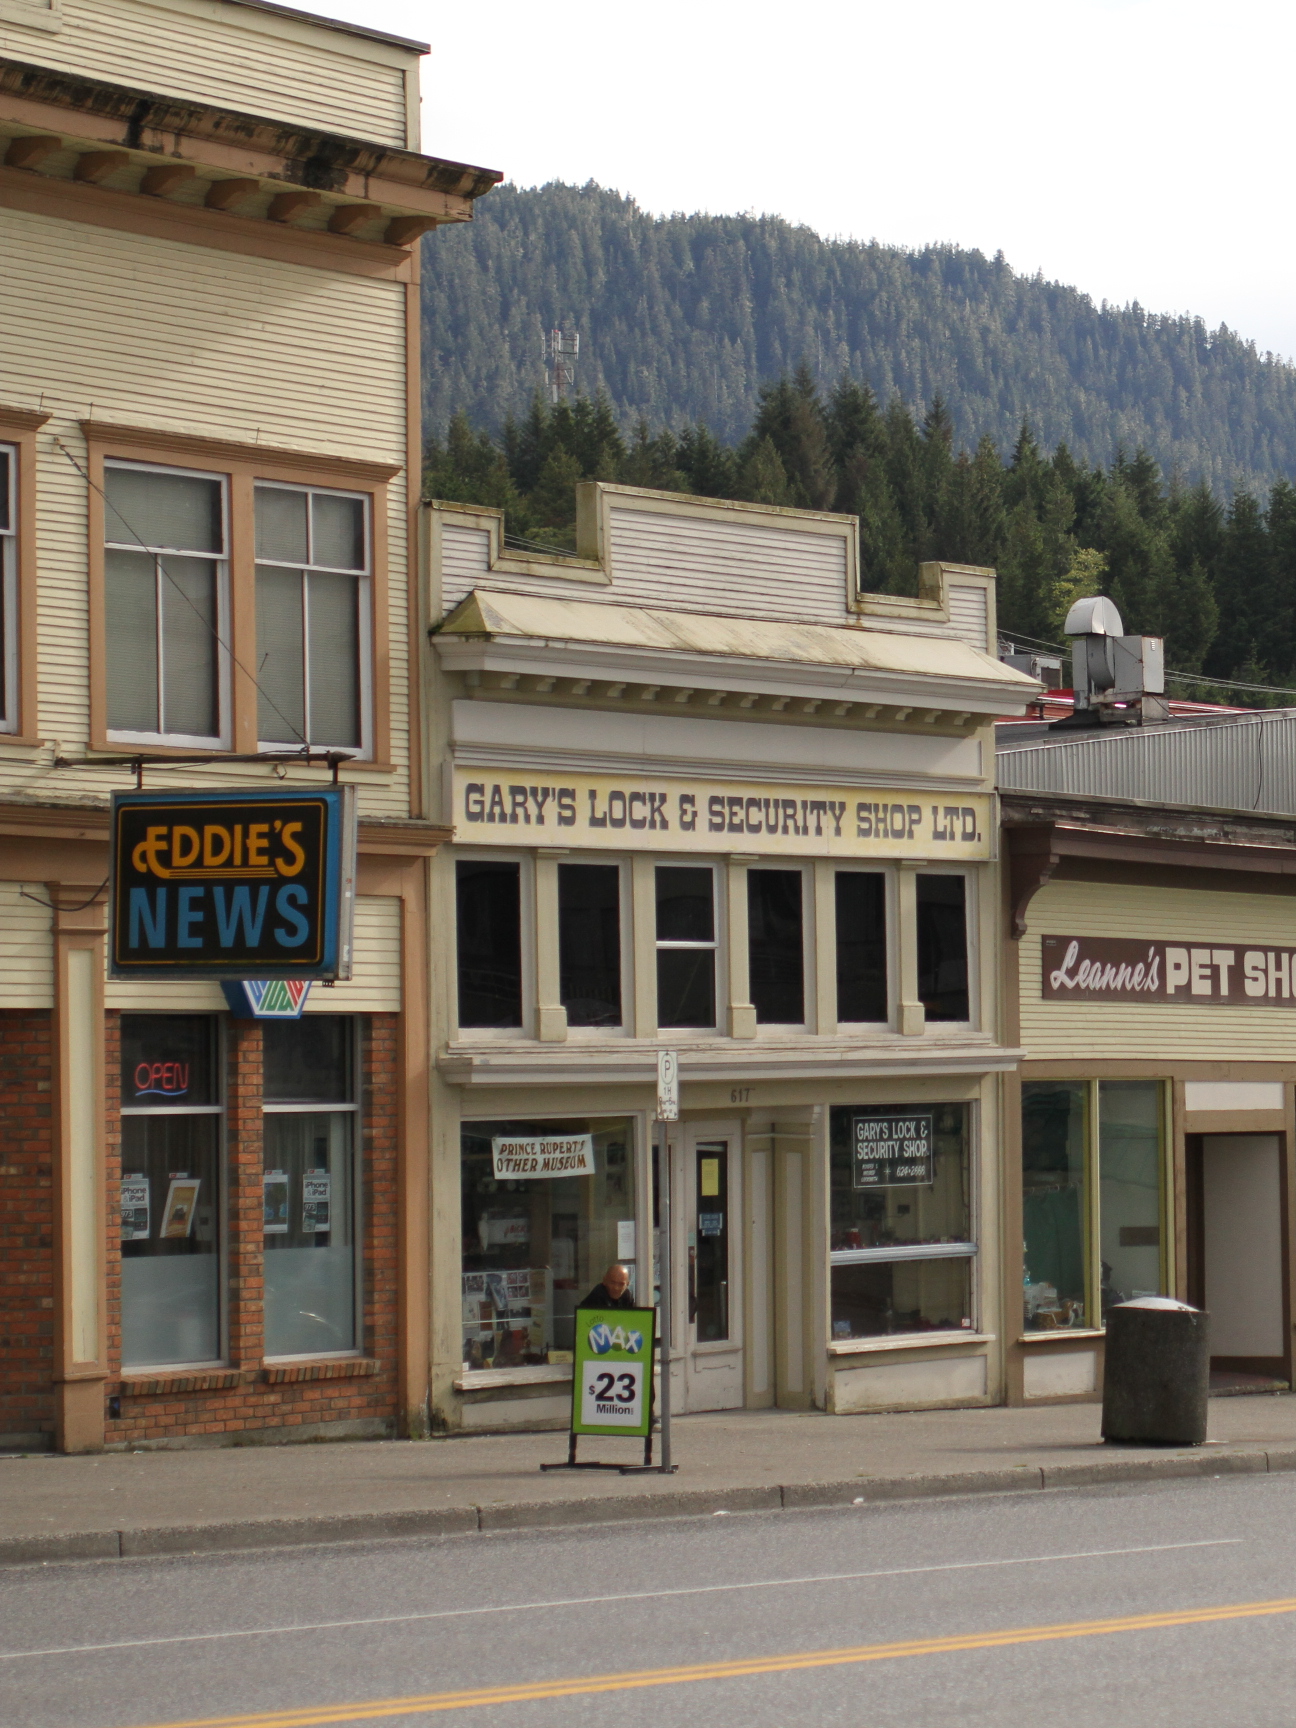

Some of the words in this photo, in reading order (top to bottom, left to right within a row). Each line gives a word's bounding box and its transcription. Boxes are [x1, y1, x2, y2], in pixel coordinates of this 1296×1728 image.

[465, 783, 576, 826] GARY'S
[588, 789, 669, 830] LOCK
[679, 794, 698, 832] &
[708, 795, 846, 837] SECURITY
[856, 802, 922, 840] SHOP
[932, 805, 981, 842] LTD.
[132, 820, 305, 879] EDDIE'S
[128, 884, 310, 948] NEWS
[1050, 940, 1159, 992] Leanne's
[1166, 947, 1235, 996] PET
[134, 1063, 189, 1089] OPEN
[664, 1060, 670, 1078] P
[731, 1088, 753, 1102] 617
[857, 1122, 888, 1140] GARY'S
[892, 1121, 916, 1139] LOCK
[921, 1121, 928, 1137] &
[498, 1142, 537, 1156] PRINCE
[540, 1140, 585, 1155] RUPERT'S
[857, 1141, 899, 1159] SECURITY
[903, 1140, 927, 1157] SHOP
[497, 1158, 538, 1173] OTHER
[541, 1154, 586, 1172] MUSEUM
[121, 1186, 146, 1194] iPhone
[305, 1181, 328, 1189] iPhone
[311, 1189, 327, 1197] iPad
[588, 1324, 641, 1354] MAX
[596, 1404, 630, 1415] Million
